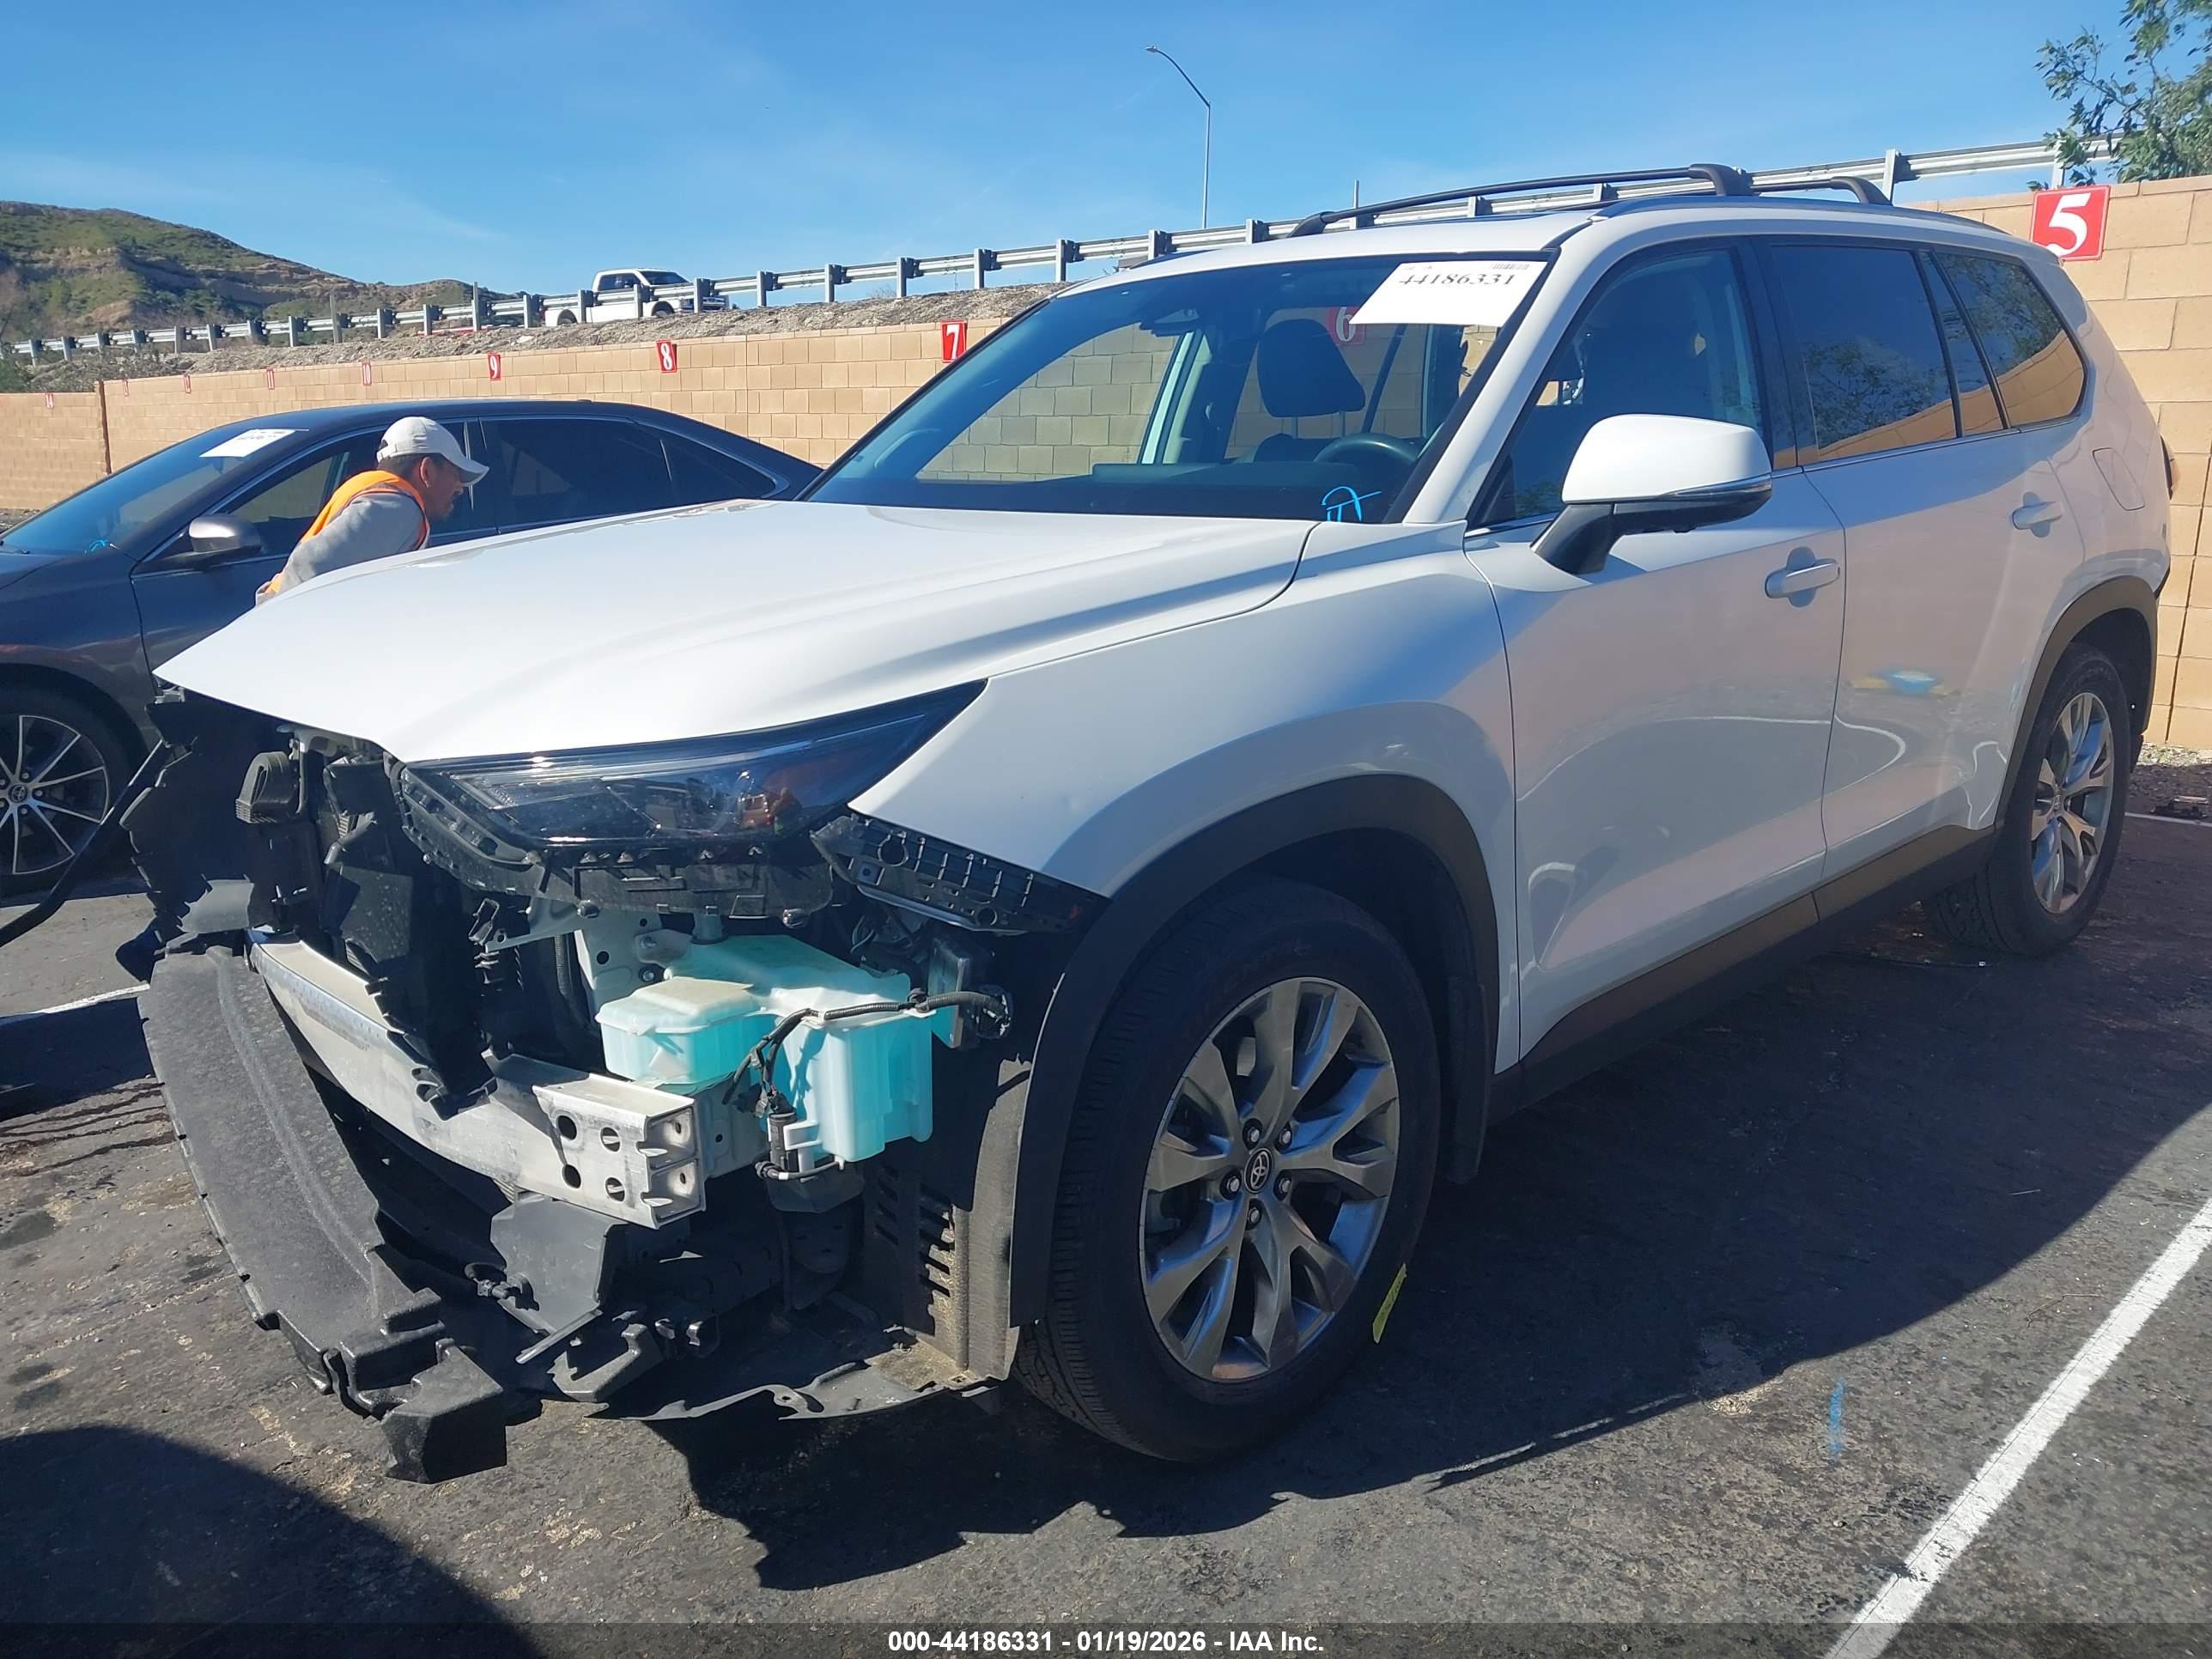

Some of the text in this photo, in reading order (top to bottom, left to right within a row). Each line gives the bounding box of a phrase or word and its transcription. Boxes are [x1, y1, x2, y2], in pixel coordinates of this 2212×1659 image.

[2047, 193, 2090, 256] 5
[1399, 272, 1516, 286] 44186331
[1336, 307, 1356, 342] 6
[946, 324, 960, 360] 7
[490, 355, 498, 379] 9
[660, 343, 672, 370] 8
[362, 362, 371, 386] 10
